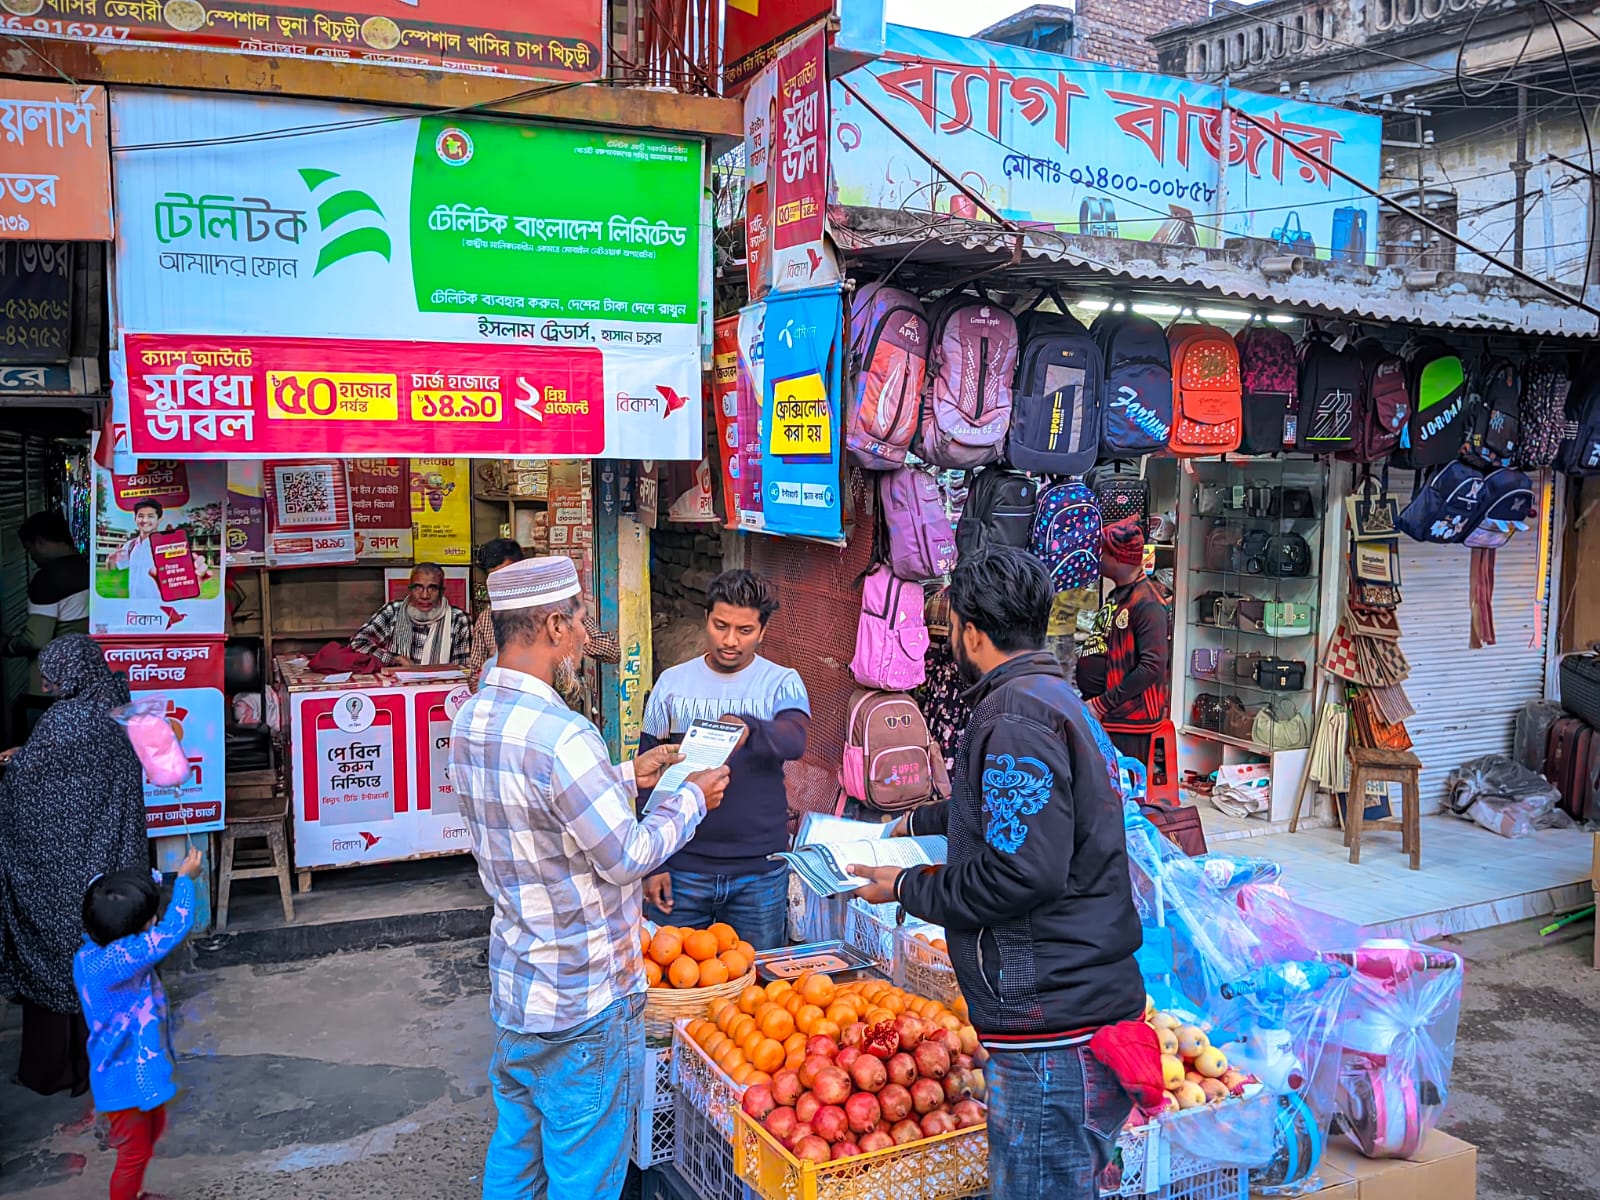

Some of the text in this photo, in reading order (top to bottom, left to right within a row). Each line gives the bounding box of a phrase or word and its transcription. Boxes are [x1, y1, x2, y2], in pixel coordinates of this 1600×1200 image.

[104, 0, 164, 22] তেহারী
[206, 8, 270, 32] স্পেশাল
[277, 17, 308, 38] ভুনা
[313, 14, 360, 43] খিচুড়ী
[400, 28, 461, 52] স্পেশাল
[467, 33, 510, 57] খাসির
[515, 40, 543, 62] চাপ
[548, 41, 591, 69] খিচুড়ী
[0, 86, 96, 148] য়লার্স
[877, 53, 1088, 153] ব্যাগ
[1105, 88, 1345, 189] বাজার
[1002, 154, 1220, 203] মোবাঃ ০১৪০০-০০৮৫৮
[155, 191, 308, 245] টেলিটক
[428, 203, 687, 247] টেলিটক বাংলাদেশ লিমিটেড
[159, 252, 299, 279] আমাদের ফোন
[430, 288, 687, 318] টেলিটক ব্যবহার করুন, দেশের টাকা দেশে রাখুন
[478, 316, 536, 341] ইসলাম
[540, 320, 596, 343] ট্রেডার্স,
[600, 329, 634, 343] হাসান
[898, 325, 920, 345] APEX
[141, 348, 253, 368] ক্যাশ আউটে
[142, 364, 254, 411] সুবিধা
[338, 382, 393, 400] হাজার
[411, 371, 501, 391] চার্জ হাজারে
[514, 376, 543, 423] ২
[543, 385, 567, 402] প্রিয়
[616, 391, 660, 413] বিকাশ
[339, 400, 369, 414] পর্যন্ত
[543, 398, 590, 416] এজেন্টে
[144, 408, 256, 442] ডাবল
[1050, 408, 1062, 435] SPORT
[784, 424, 822, 443] করা হয়
[864, 440, 893, 457] APEX
[352, 500, 372, 510] বাইল
[368, 536, 400, 550] নগদ
[126, 611, 162, 626] বিকাশ
[104, 646, 210, 663] লেনদেন করুন
[128, 664, 187, 682] নিশ্চিন্তে
[328, 742, 382, 762] পে বিল
[337, 760, 375, 774] করুন
[330, 773, 382, 791] নিশ্চিন্তে
[332, 838, 362, 852] বিকাশ
